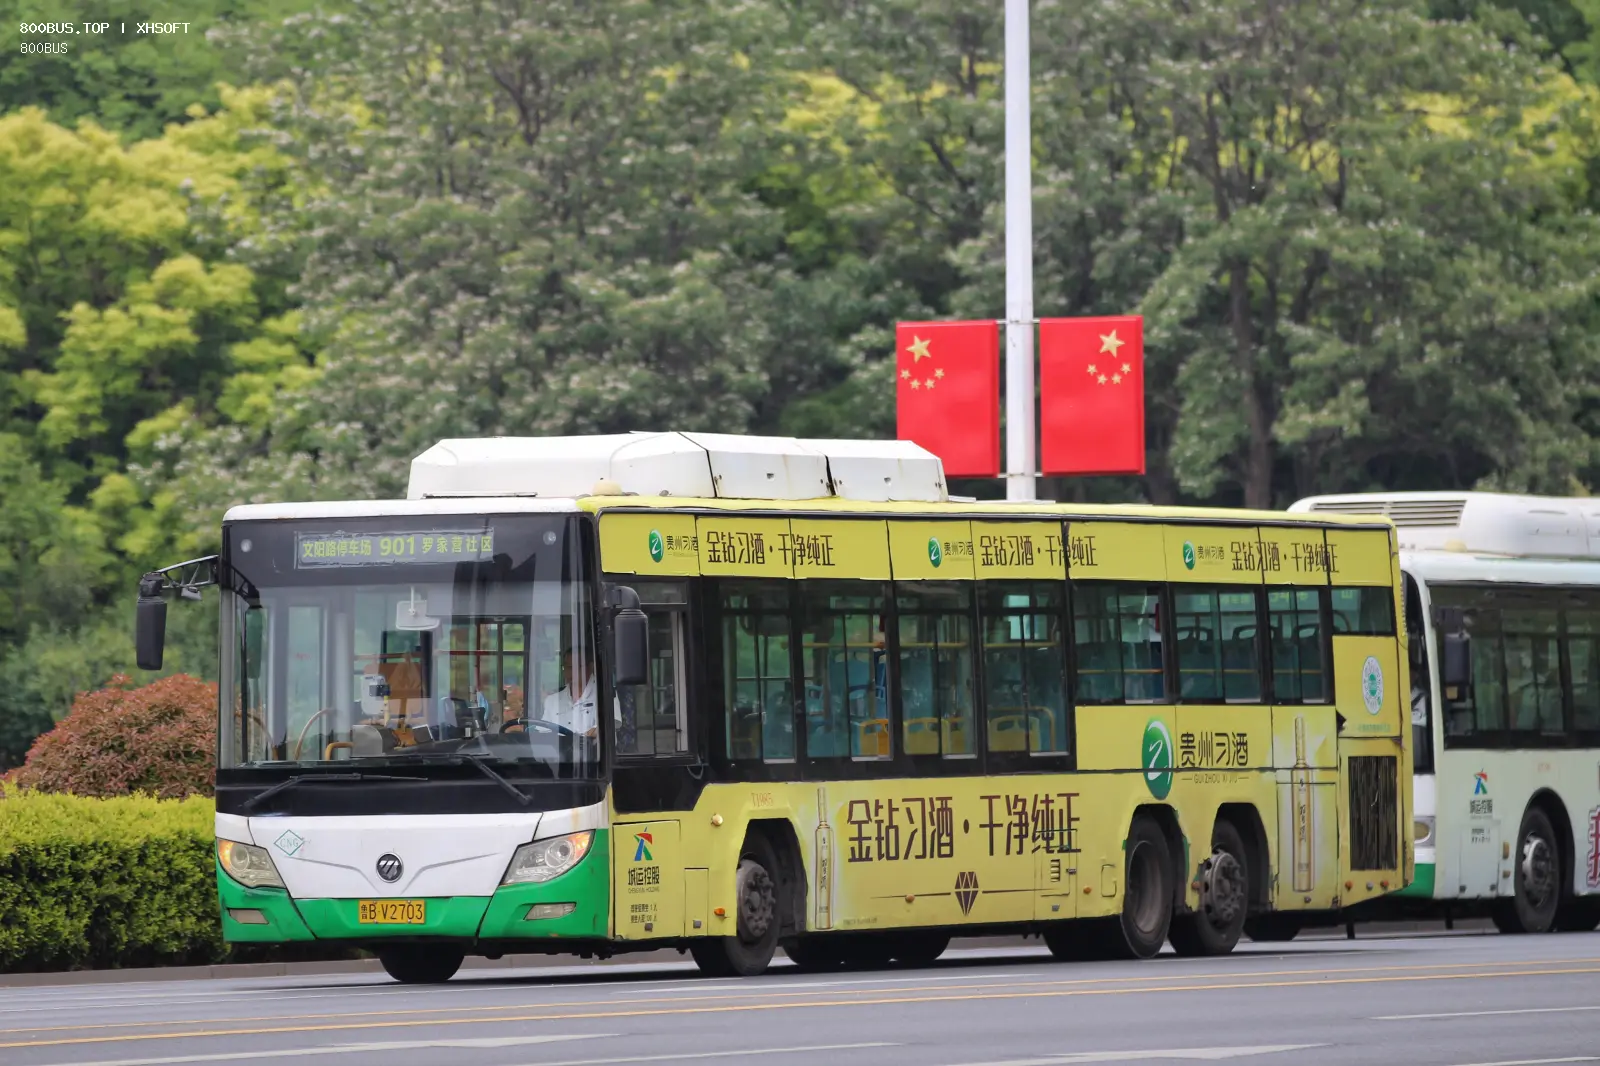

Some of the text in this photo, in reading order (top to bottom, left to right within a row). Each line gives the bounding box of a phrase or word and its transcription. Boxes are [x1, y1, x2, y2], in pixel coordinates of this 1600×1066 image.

[303, 535, 493, 557] 文阳路停车场 901 罗家营社区
[666, 534, 698, 551] 贵州习酒
[1179, 731, 1249, 768] 贵州习酒
[280, 838, 299, 848] CNG
[628, 866, 660, 886] 城运控股
